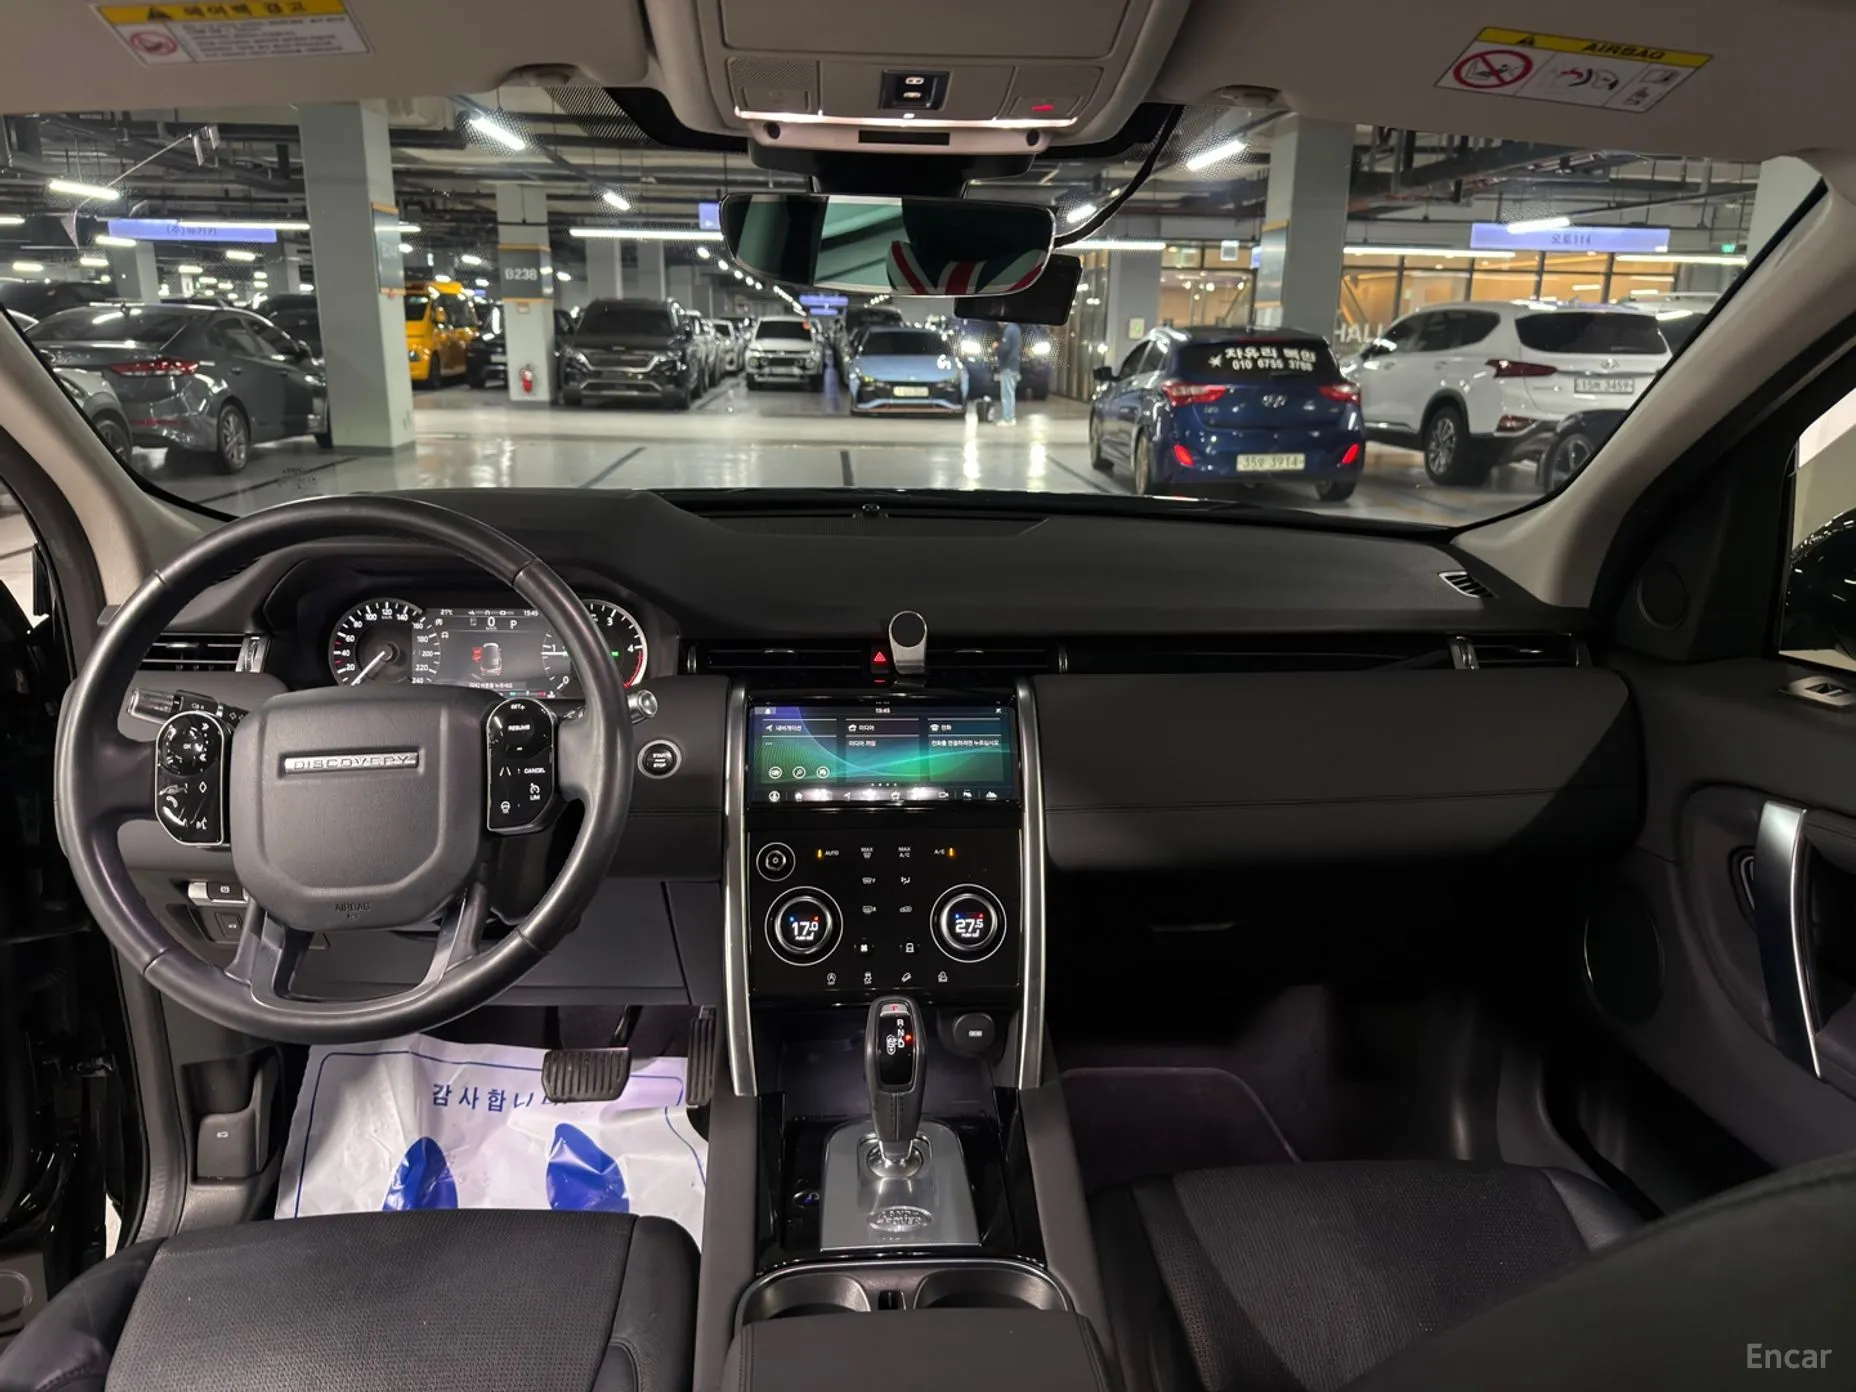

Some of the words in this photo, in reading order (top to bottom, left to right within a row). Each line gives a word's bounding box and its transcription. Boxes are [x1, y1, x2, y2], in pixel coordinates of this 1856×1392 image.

[1581, 42, 1667, 60] AIRBAG
[1232, 358, 1253, 371] 010
[366, 613, 378, 621] 100
[396, 613, 409, 621] 140
[487, 616, 496, 627] 0
[606, 617, 613, 626] 3
[510, 620, 517, 629] P
[417, 635, 429, 643] 180
[627, 644, 634, 653] 4
[562, 676, 569, 684] 0
[292, 755, 410, 770] DISCOVERY
[791, 921, 819, 936] 17.0
[955, 918, 984, 934] 27.5
[432, 1083, 567, 1112] 감사합니
